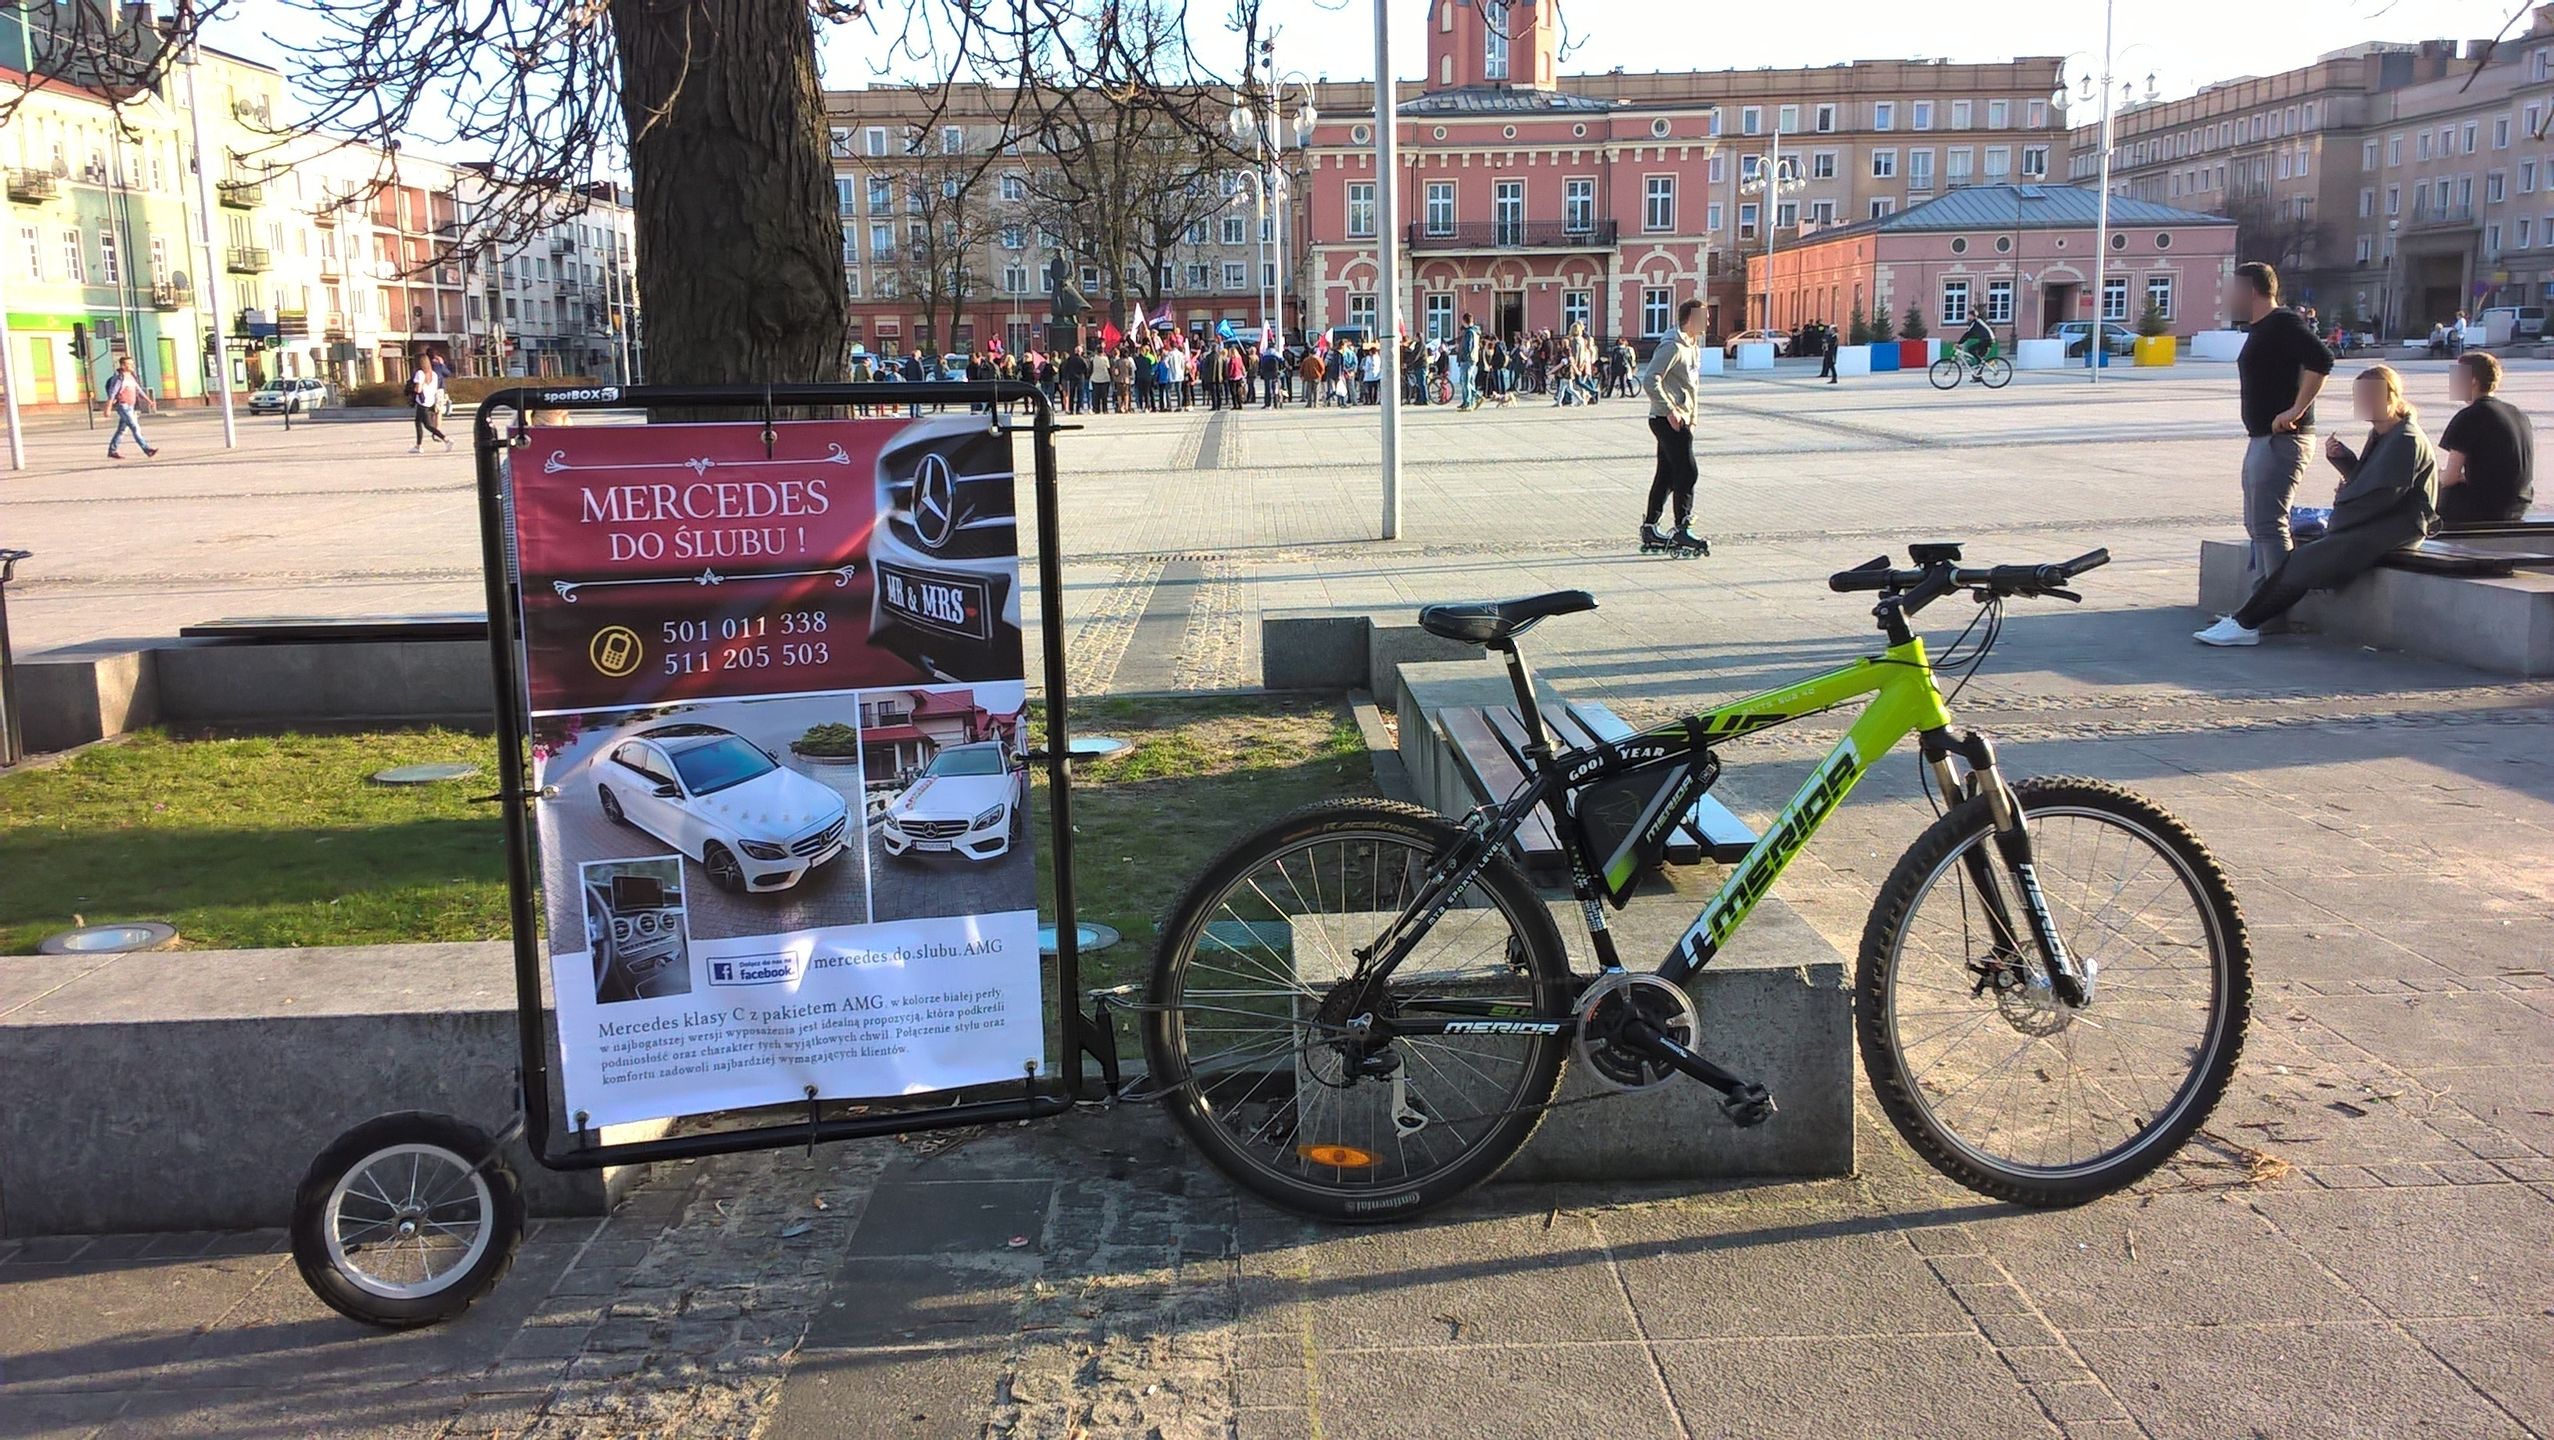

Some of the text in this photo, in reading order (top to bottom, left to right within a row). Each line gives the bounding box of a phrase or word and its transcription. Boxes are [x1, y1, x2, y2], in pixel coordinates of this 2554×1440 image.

[543, 389, 601, 403] spotBOX
[580, 479, 830, 523] MERCEDES
[608, 530, 664, 561] DO
[674, 524, 786, 559] ŚLUBU
[885, 573, 965, 625] MR & MRS
[663, 610, 828, 644] 501 011 338
[664, 641, 829, 675] 511 205 503
[1644, 773, 1694, 844] MERIDA
[1447, 869, 1478, 904] SPORTS
[1477, 840, 1505, 868] LEVEL
[1688, 741, 1861, 960] MERIDA
[2018, 863, 2073, 976] MERIDA
[598, 1016, 680, 1039] Mercedes
[683, 1010, 728, 1027] klasy
[732, 1006, 745, 1021] C
[749, 1010, 758, 1021] z
[762, 1001, 837, 1025] pakietem
[890, 999, 900, 1007] w
[902, 993, 941, 1006] kolorze
[943, 991, 974, 1004] białej
[599, 1044, 609, 1053] w
[613, 1036, 685, 1052] najbogatszej
[687, 1030, 723, 1043] wersji
[725, 1025, 796, 1040] wyposażenia
[798, 1021, 818, 1036] jest
[821, 1016, 861, 1029] idealną
[926, 1008, 955, 1020] która
[957, 1001, 1005, 1020] podkreśli
[1442, 1020, 1561, 1036] MERIDA
[601, 1051, 669, 1072] podniosłość
[672, 1048, 697, 1060] oraz
[700, 1040, 754, 1056] charakter
[758, 1039, 782, 1051] tych
[784, 1031, 857, 1051] wyjątkowych
[895, 1024, 951, 1040] Połączenie
[954, 1018, 981, 1032] stylu
[983, 1018, 1005, 1028] oraz
[602, 1070, 656, 1085] komfortu
[659, 1061, 710, 1078] zadowoli
[713, 1055, 776, 1073] najbardziej
[777, 1047, 858, 1066] wymagających
[1356, 1191, 1421, 1212] Continental
